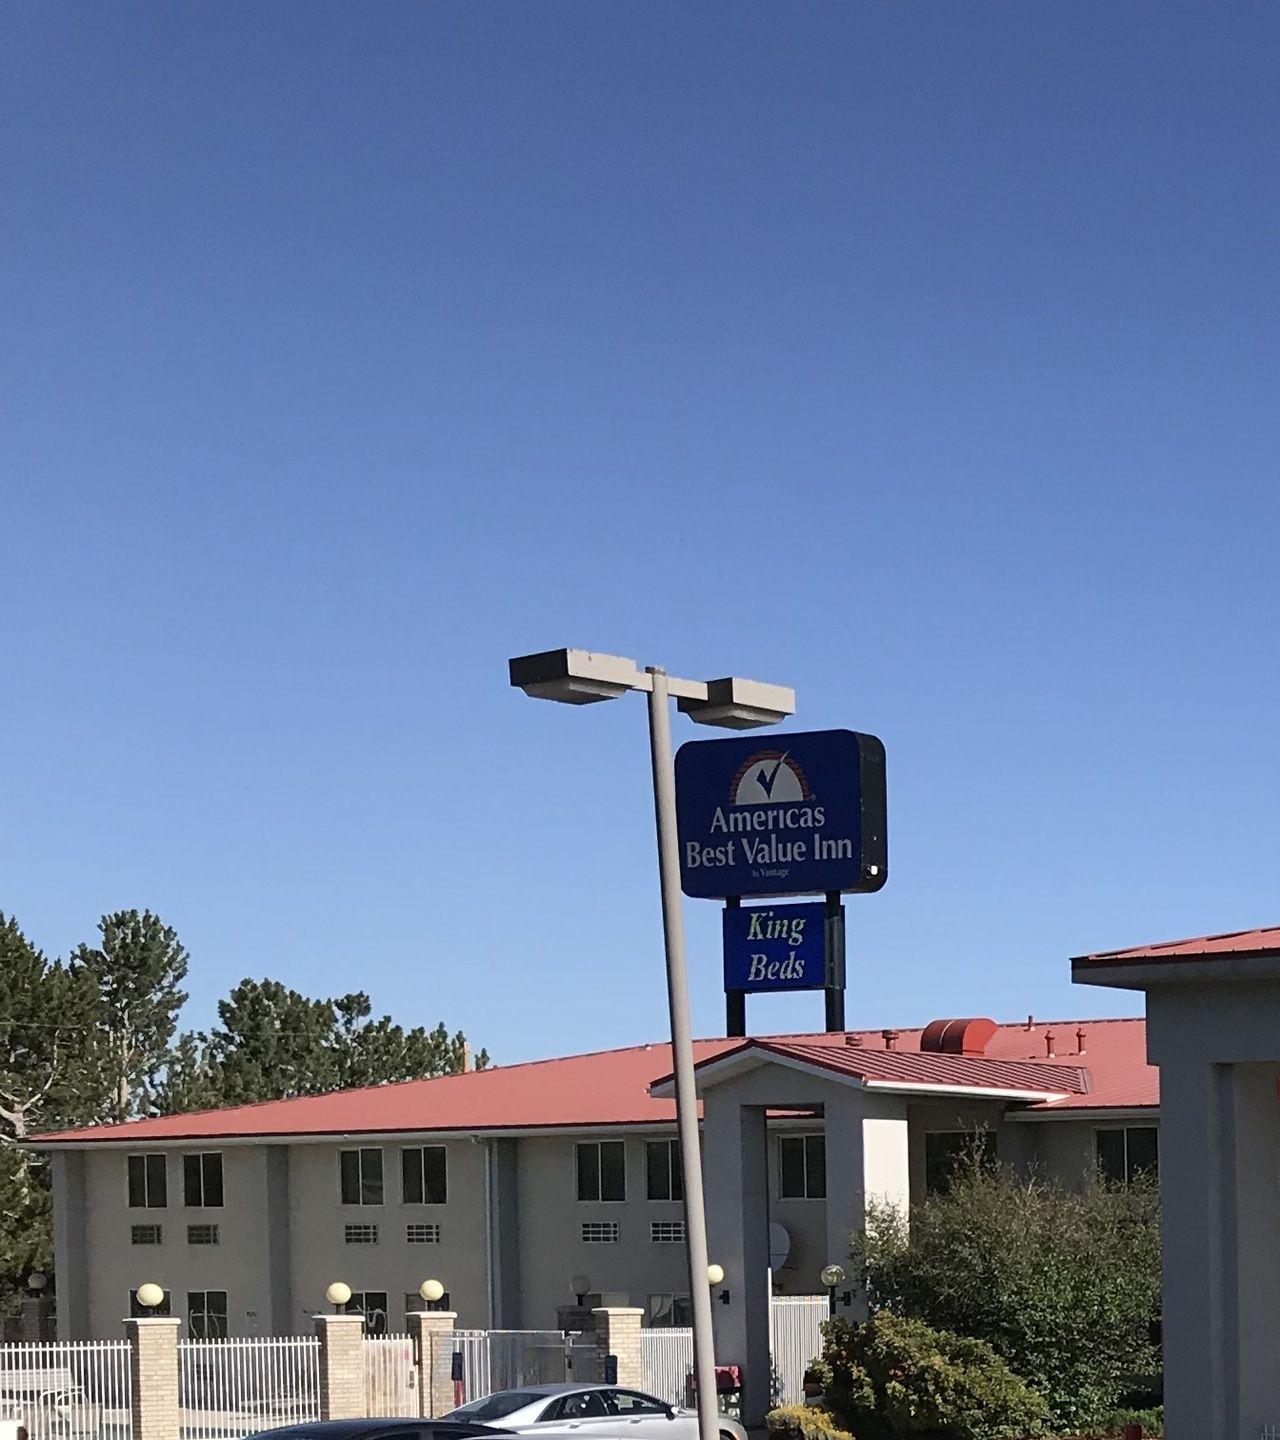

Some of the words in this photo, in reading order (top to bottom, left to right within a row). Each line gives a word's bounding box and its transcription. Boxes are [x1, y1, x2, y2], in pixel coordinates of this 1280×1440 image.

[710, 806, 826, 834] Americas
[686, 839, 736, 868] Best
[741, 834, 806, 865] Value
[814, 833, 852, 861] Inn
[747, 911, 806, 946] King
[748, 951, 805, 981] Beds
